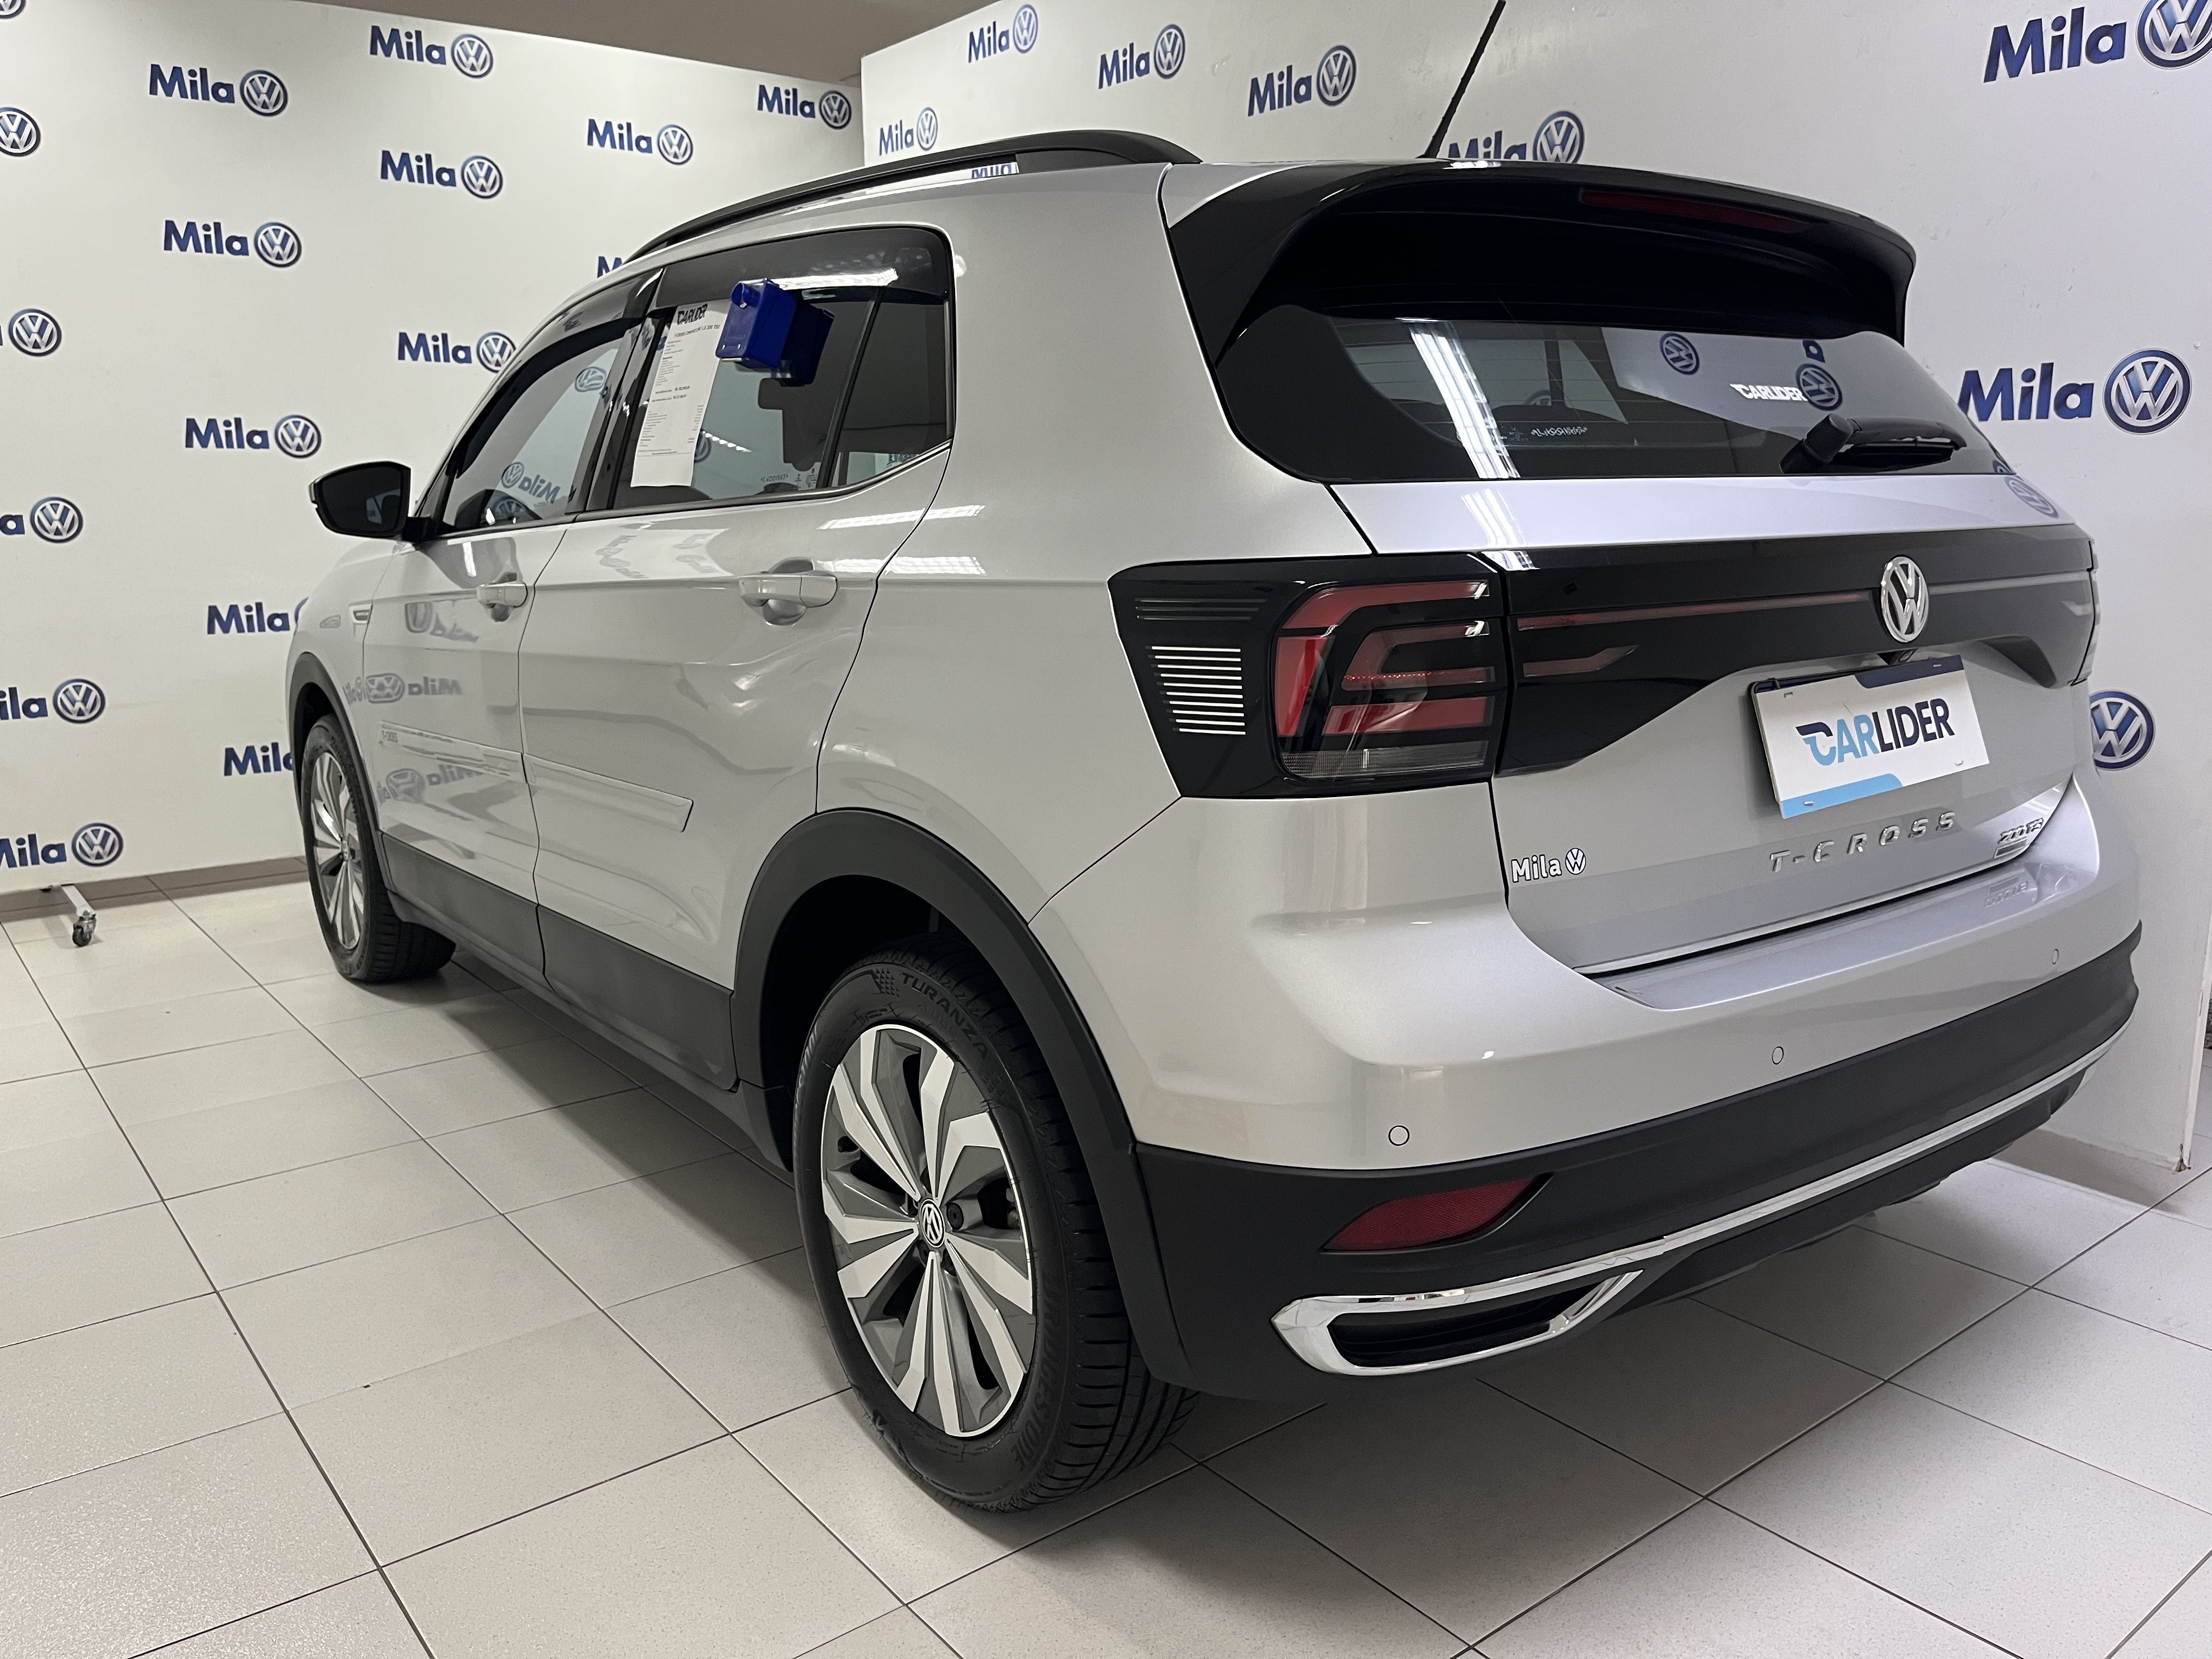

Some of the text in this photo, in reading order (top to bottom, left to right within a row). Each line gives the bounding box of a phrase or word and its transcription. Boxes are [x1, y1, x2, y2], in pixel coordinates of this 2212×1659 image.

[370, 26, 447, 65] Mila
[968, 21, 1009, 63] Mila
[1983, 7, 2127, 83] Mila
[150, 64, 235, 103] Mila
[1099, 42, 1149, 89] Mila
[758, 85, 815, 118] Mila
[1248, 65, 1312, 117] Mila
[587, 119, 652, 153] Mila
[879, 120, 914, 156] Mila
[381, 150, 456, 187] Mila
[164, 220, 249, 256] Mila
[398, 332, 472, 364] Mila
[1729, 384, 1808, 401] CARLIDER
[1957, 363, 2094, 421] Mila
[185, 417, 269, 449] Mila
[207, 602, 290, 634] Mila
[0, 687, 48, 720] ila
[1796, 698, 1955, 766] CARLIDER
[1770, 811, 1955, 873] T-CROSS
[1511, 854, 1562, 883] Mila
[902, 972, 988, 1061] TURANZA
